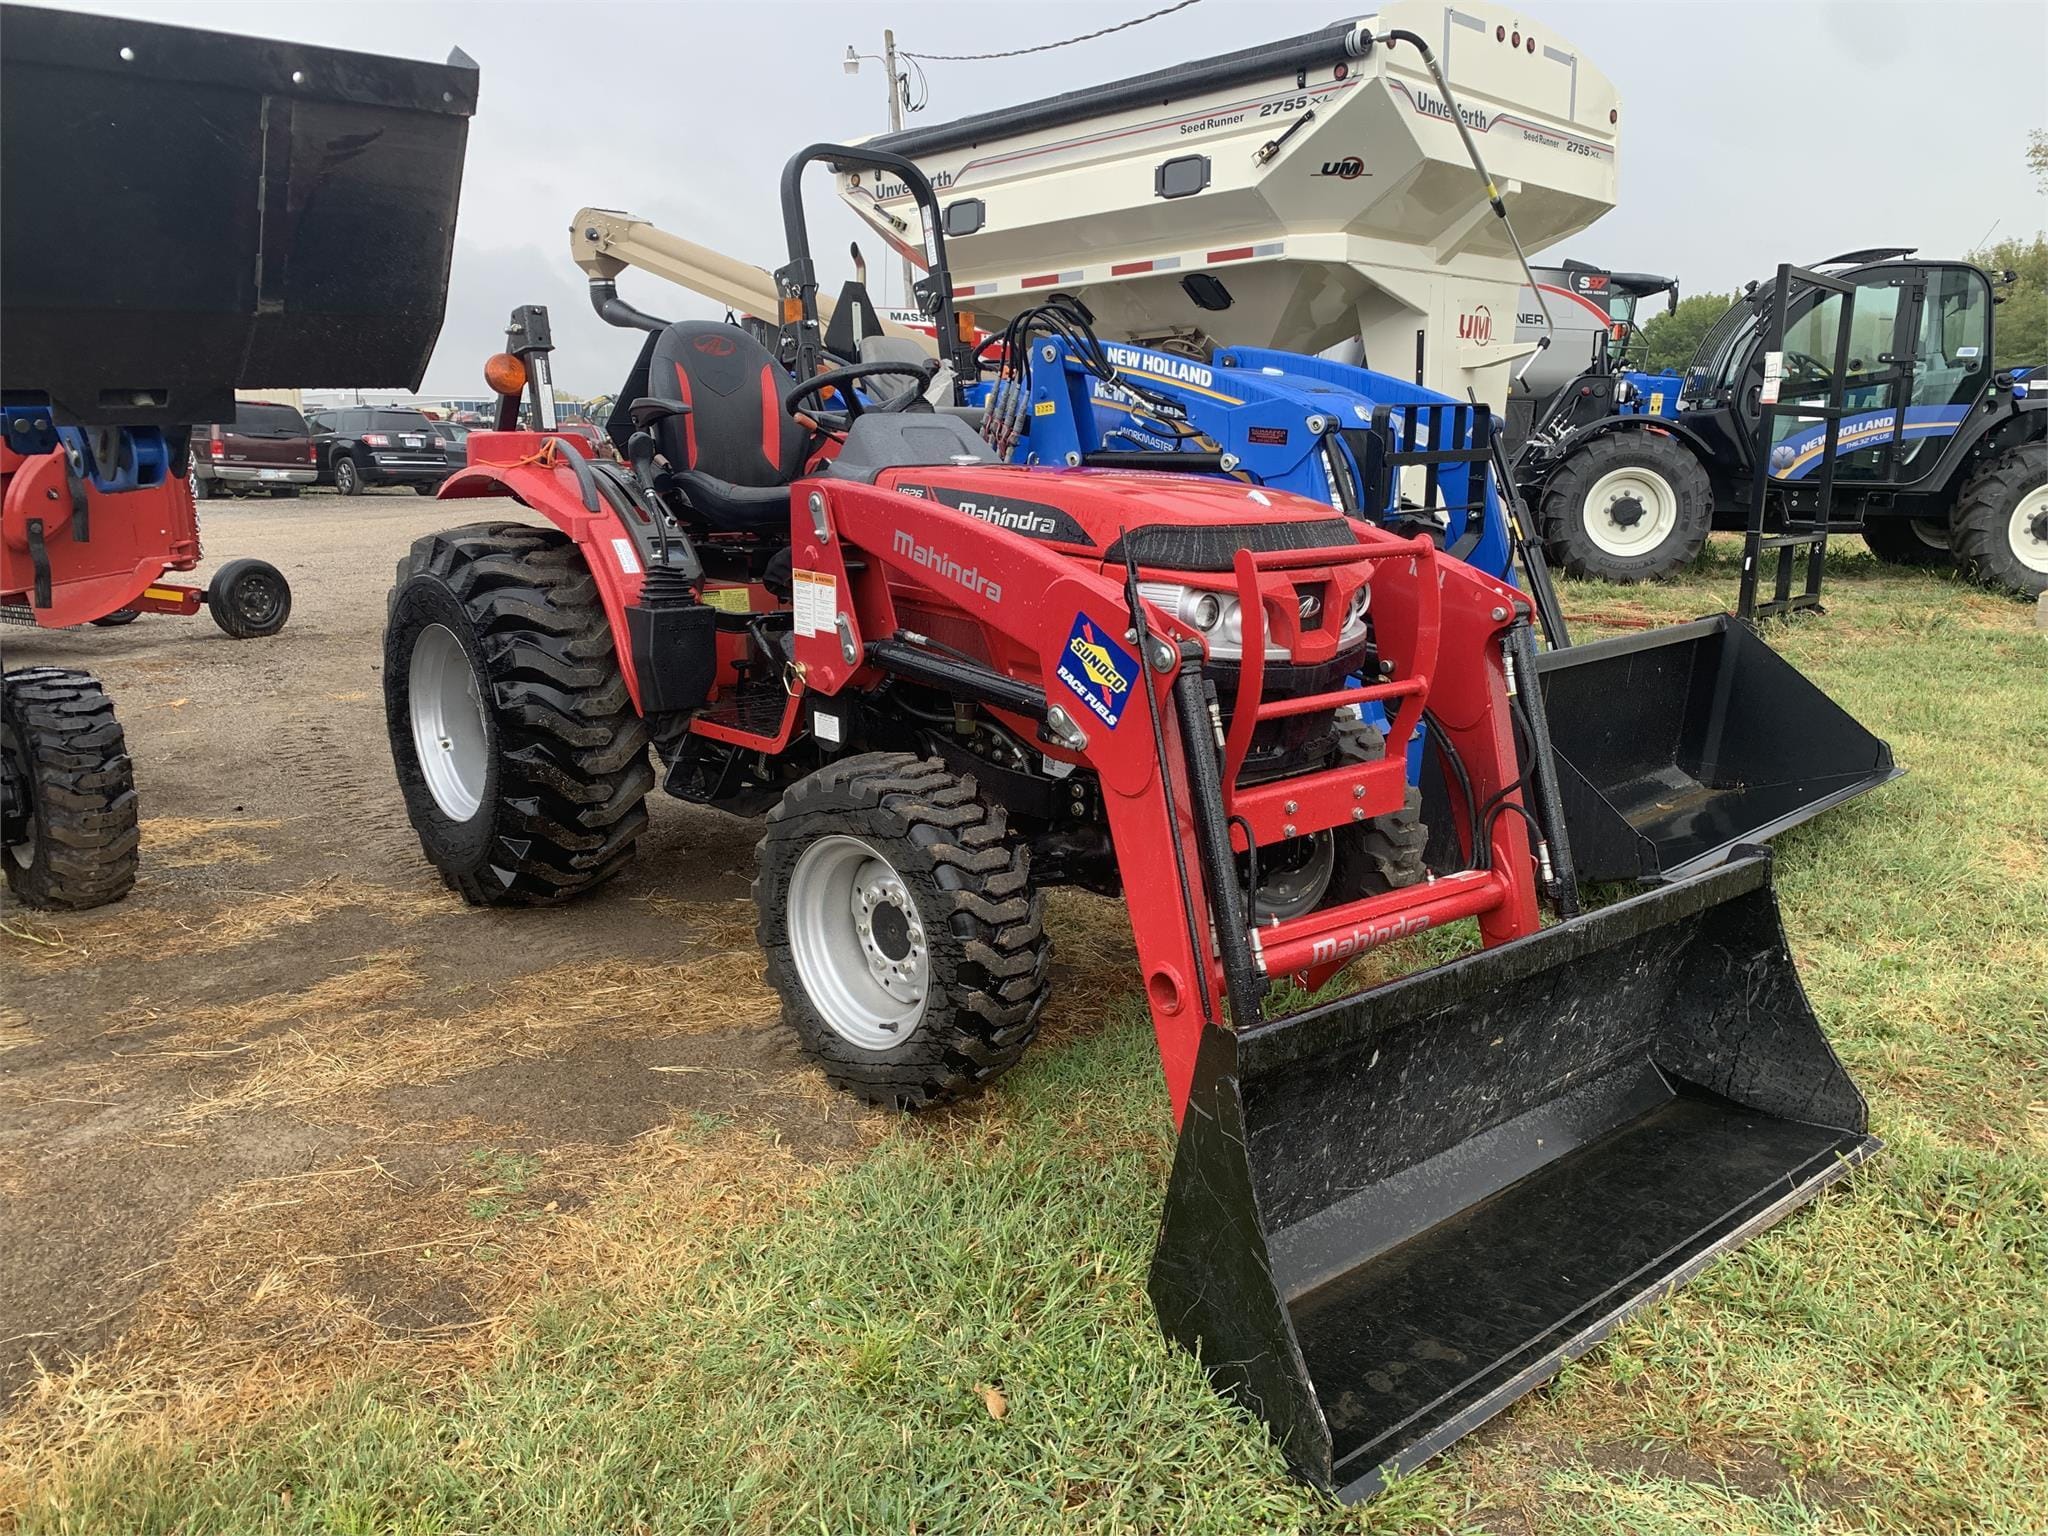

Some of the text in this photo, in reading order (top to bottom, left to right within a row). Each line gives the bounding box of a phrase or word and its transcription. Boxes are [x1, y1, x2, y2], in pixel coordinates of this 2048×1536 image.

[1417, 91, 1487, 129] Unveerth
[876, 170, 952, 199] Unverth
[1579, 276, 1608, 289] S97
[1107, 347, 1213, 388] NEW HOLLAND
[1120, 426, 1174, 452] WORKMASTER
[959, 502, 1056, 534] Mahindra
[893, 528, 1002, 604] Mahindra
[1072, 640, 1126, 691] SUNOCO
[1057, 664, 1118, 726] RACE FUELS
[1312, 915, 1430, 965] Mahindra
